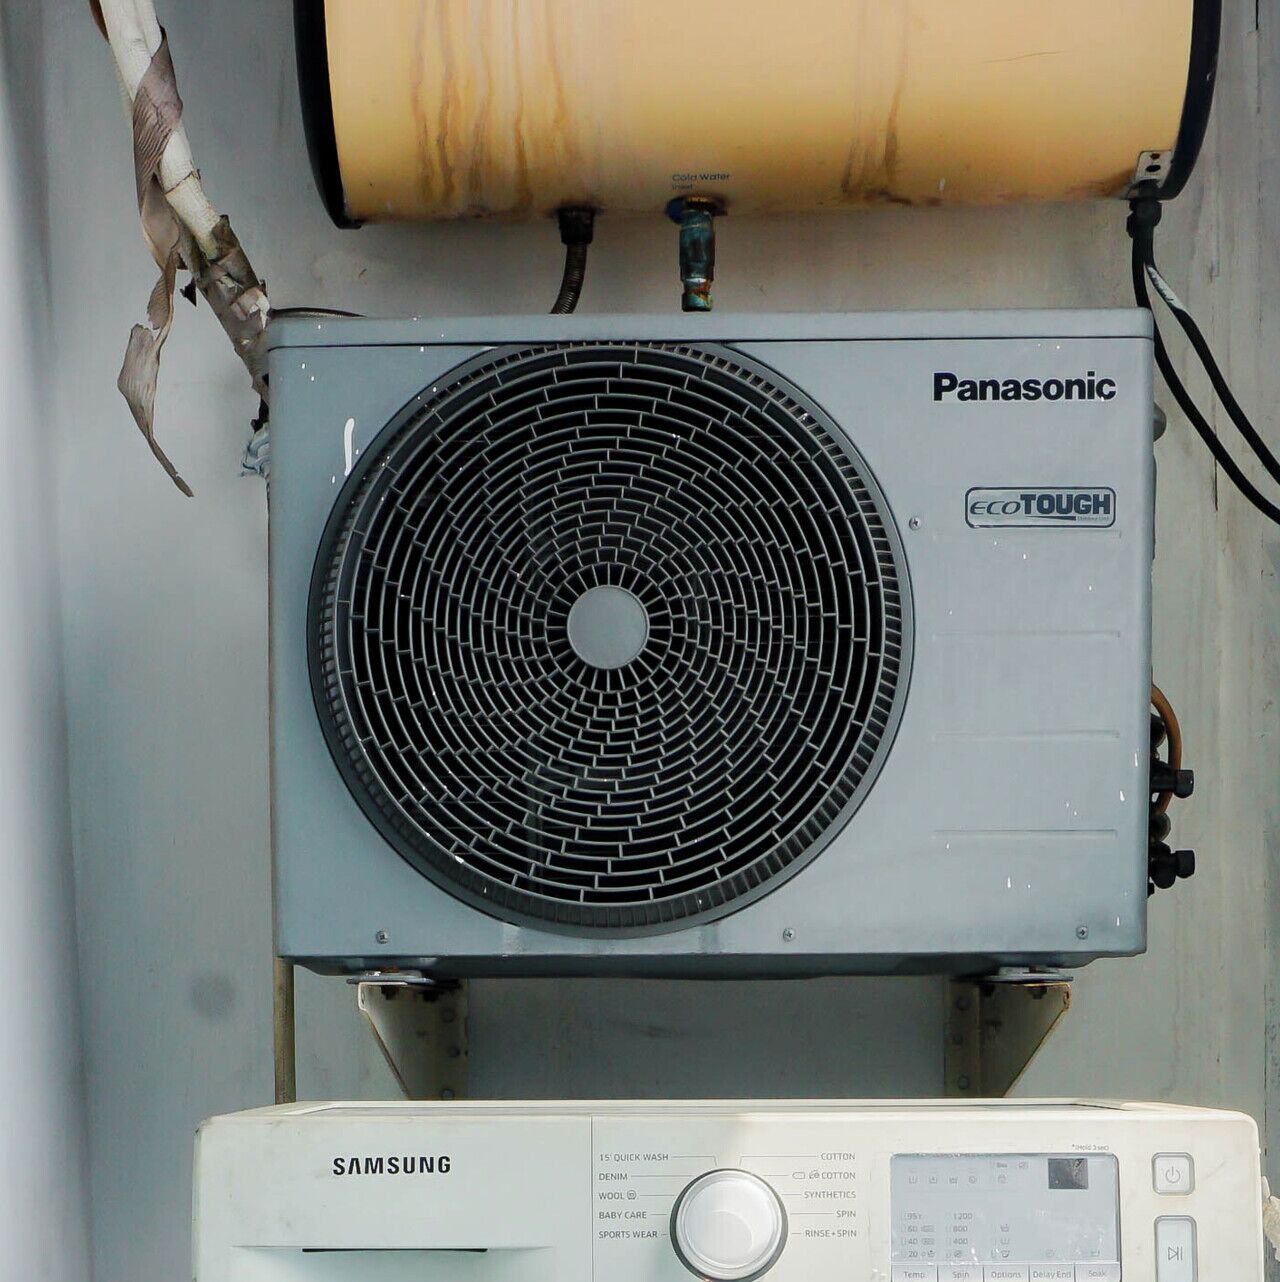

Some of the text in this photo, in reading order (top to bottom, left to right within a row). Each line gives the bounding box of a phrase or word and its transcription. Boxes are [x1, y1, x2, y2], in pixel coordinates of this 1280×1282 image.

[933, 371, 1116, 401] Panasonic
[614, 1153, 640, 1162] QUICK
[643, 1153, 669, 1161] WASH
[821, 1152, 856, 1160] COTTON
[333, 1156, 451, 1175] SAMSUNG
[599, 1172, 628, 1181] DENIM
[821, 1171, 856, 1180] COTTON
[598, 1191, 624, 1200] WOOL
[804, 1190, 856, 1199] SYNTHETICS
[598, 1211, 647, 1220] BABY CARE
[836, 1210, 856, 1218] SPIN
[598, 1230, 658, 1239] SPORTS WEAR
[805, 1229, 857, 1238] RINSE+SPIN
[952, 1271, 970, 1280] Spin
[991, 1271, 1021, 1280] Options
[1033, 1271, 1071, 1279] Delay End
